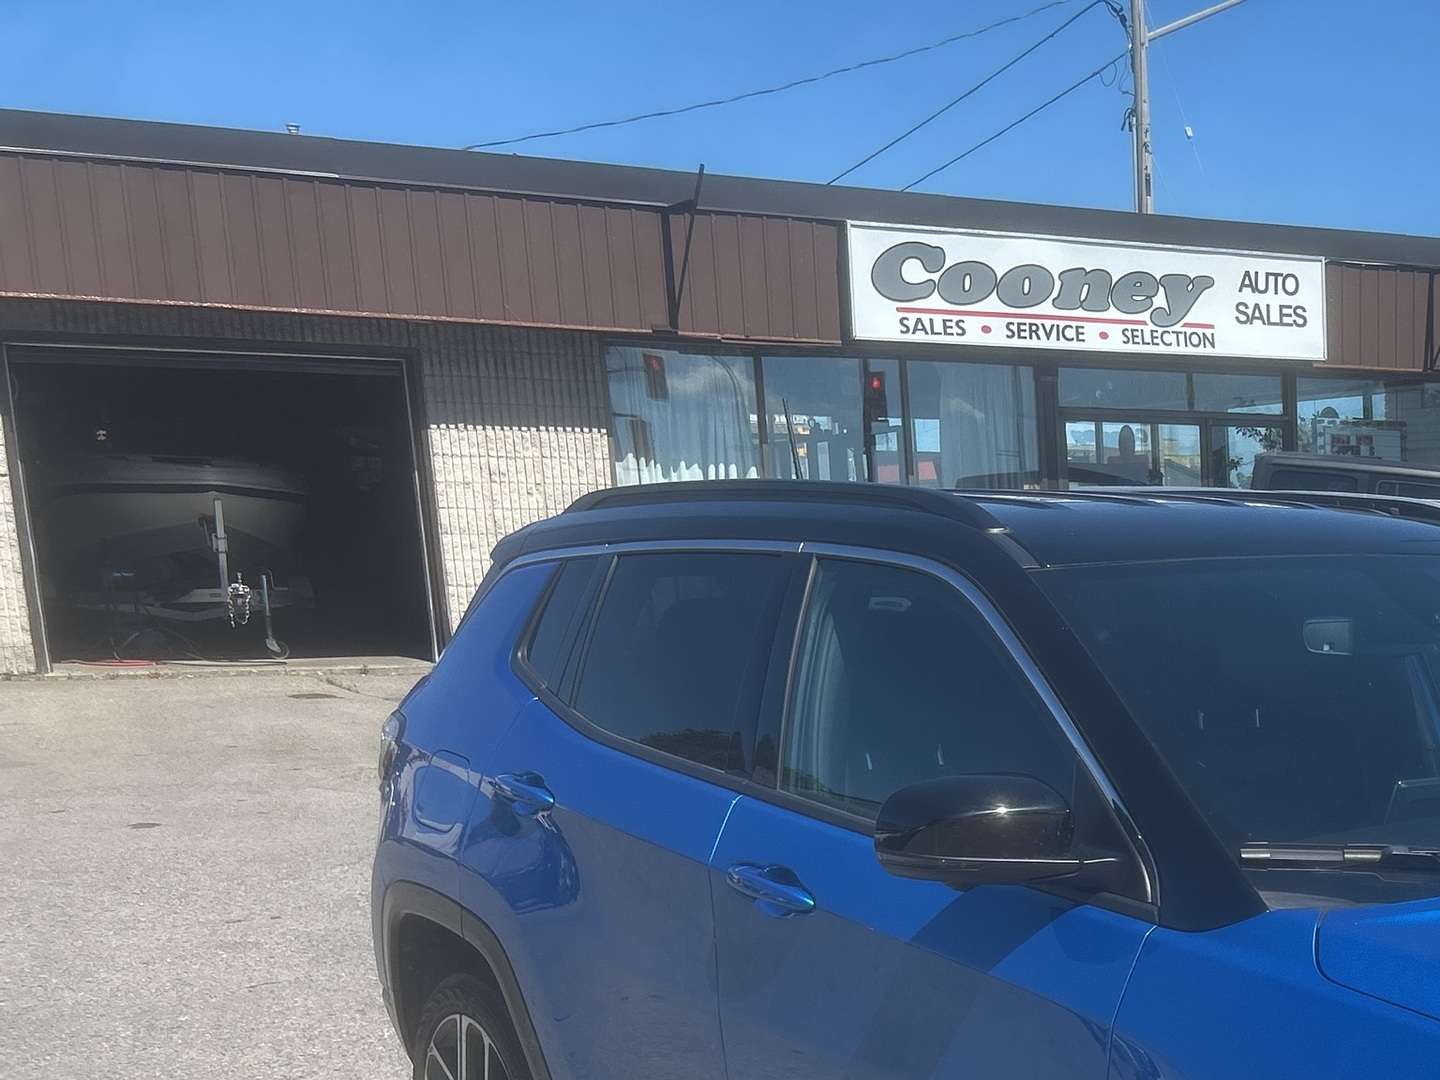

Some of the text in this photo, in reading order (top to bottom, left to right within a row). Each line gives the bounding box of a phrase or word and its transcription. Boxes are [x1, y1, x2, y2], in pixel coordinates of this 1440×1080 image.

[871, 241, 1215, 328] Cooney
[1238, 269, 1300, 296] AUTO
[1235, 301, 1308, 328] SALES
[899, 317, 1216, 349] SALES SERVICE SELECTION
